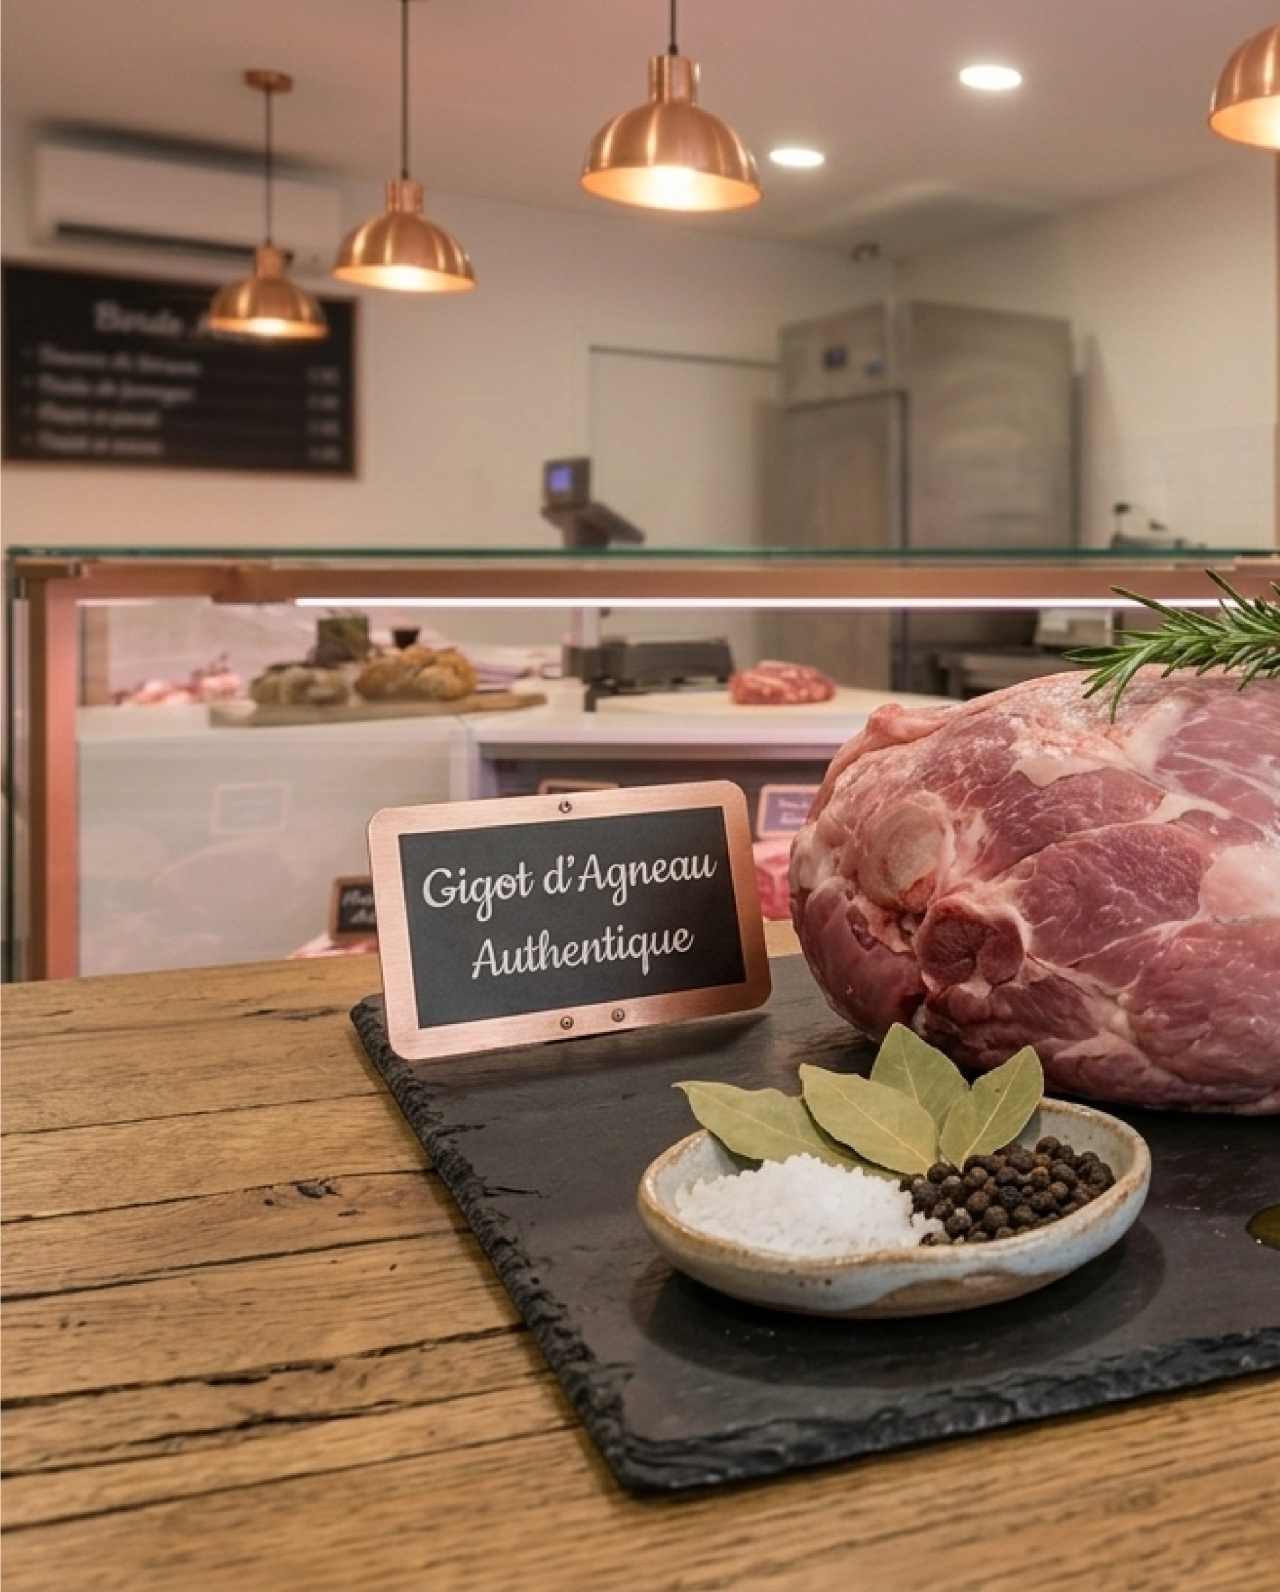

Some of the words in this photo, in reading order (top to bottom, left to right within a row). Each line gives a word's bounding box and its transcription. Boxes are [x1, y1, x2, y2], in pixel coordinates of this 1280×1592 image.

[422, 861, 535, 922] Gigot
[543, 853, 718, 906] d'Agneau
[471, 923, 695, 980] Authentique
